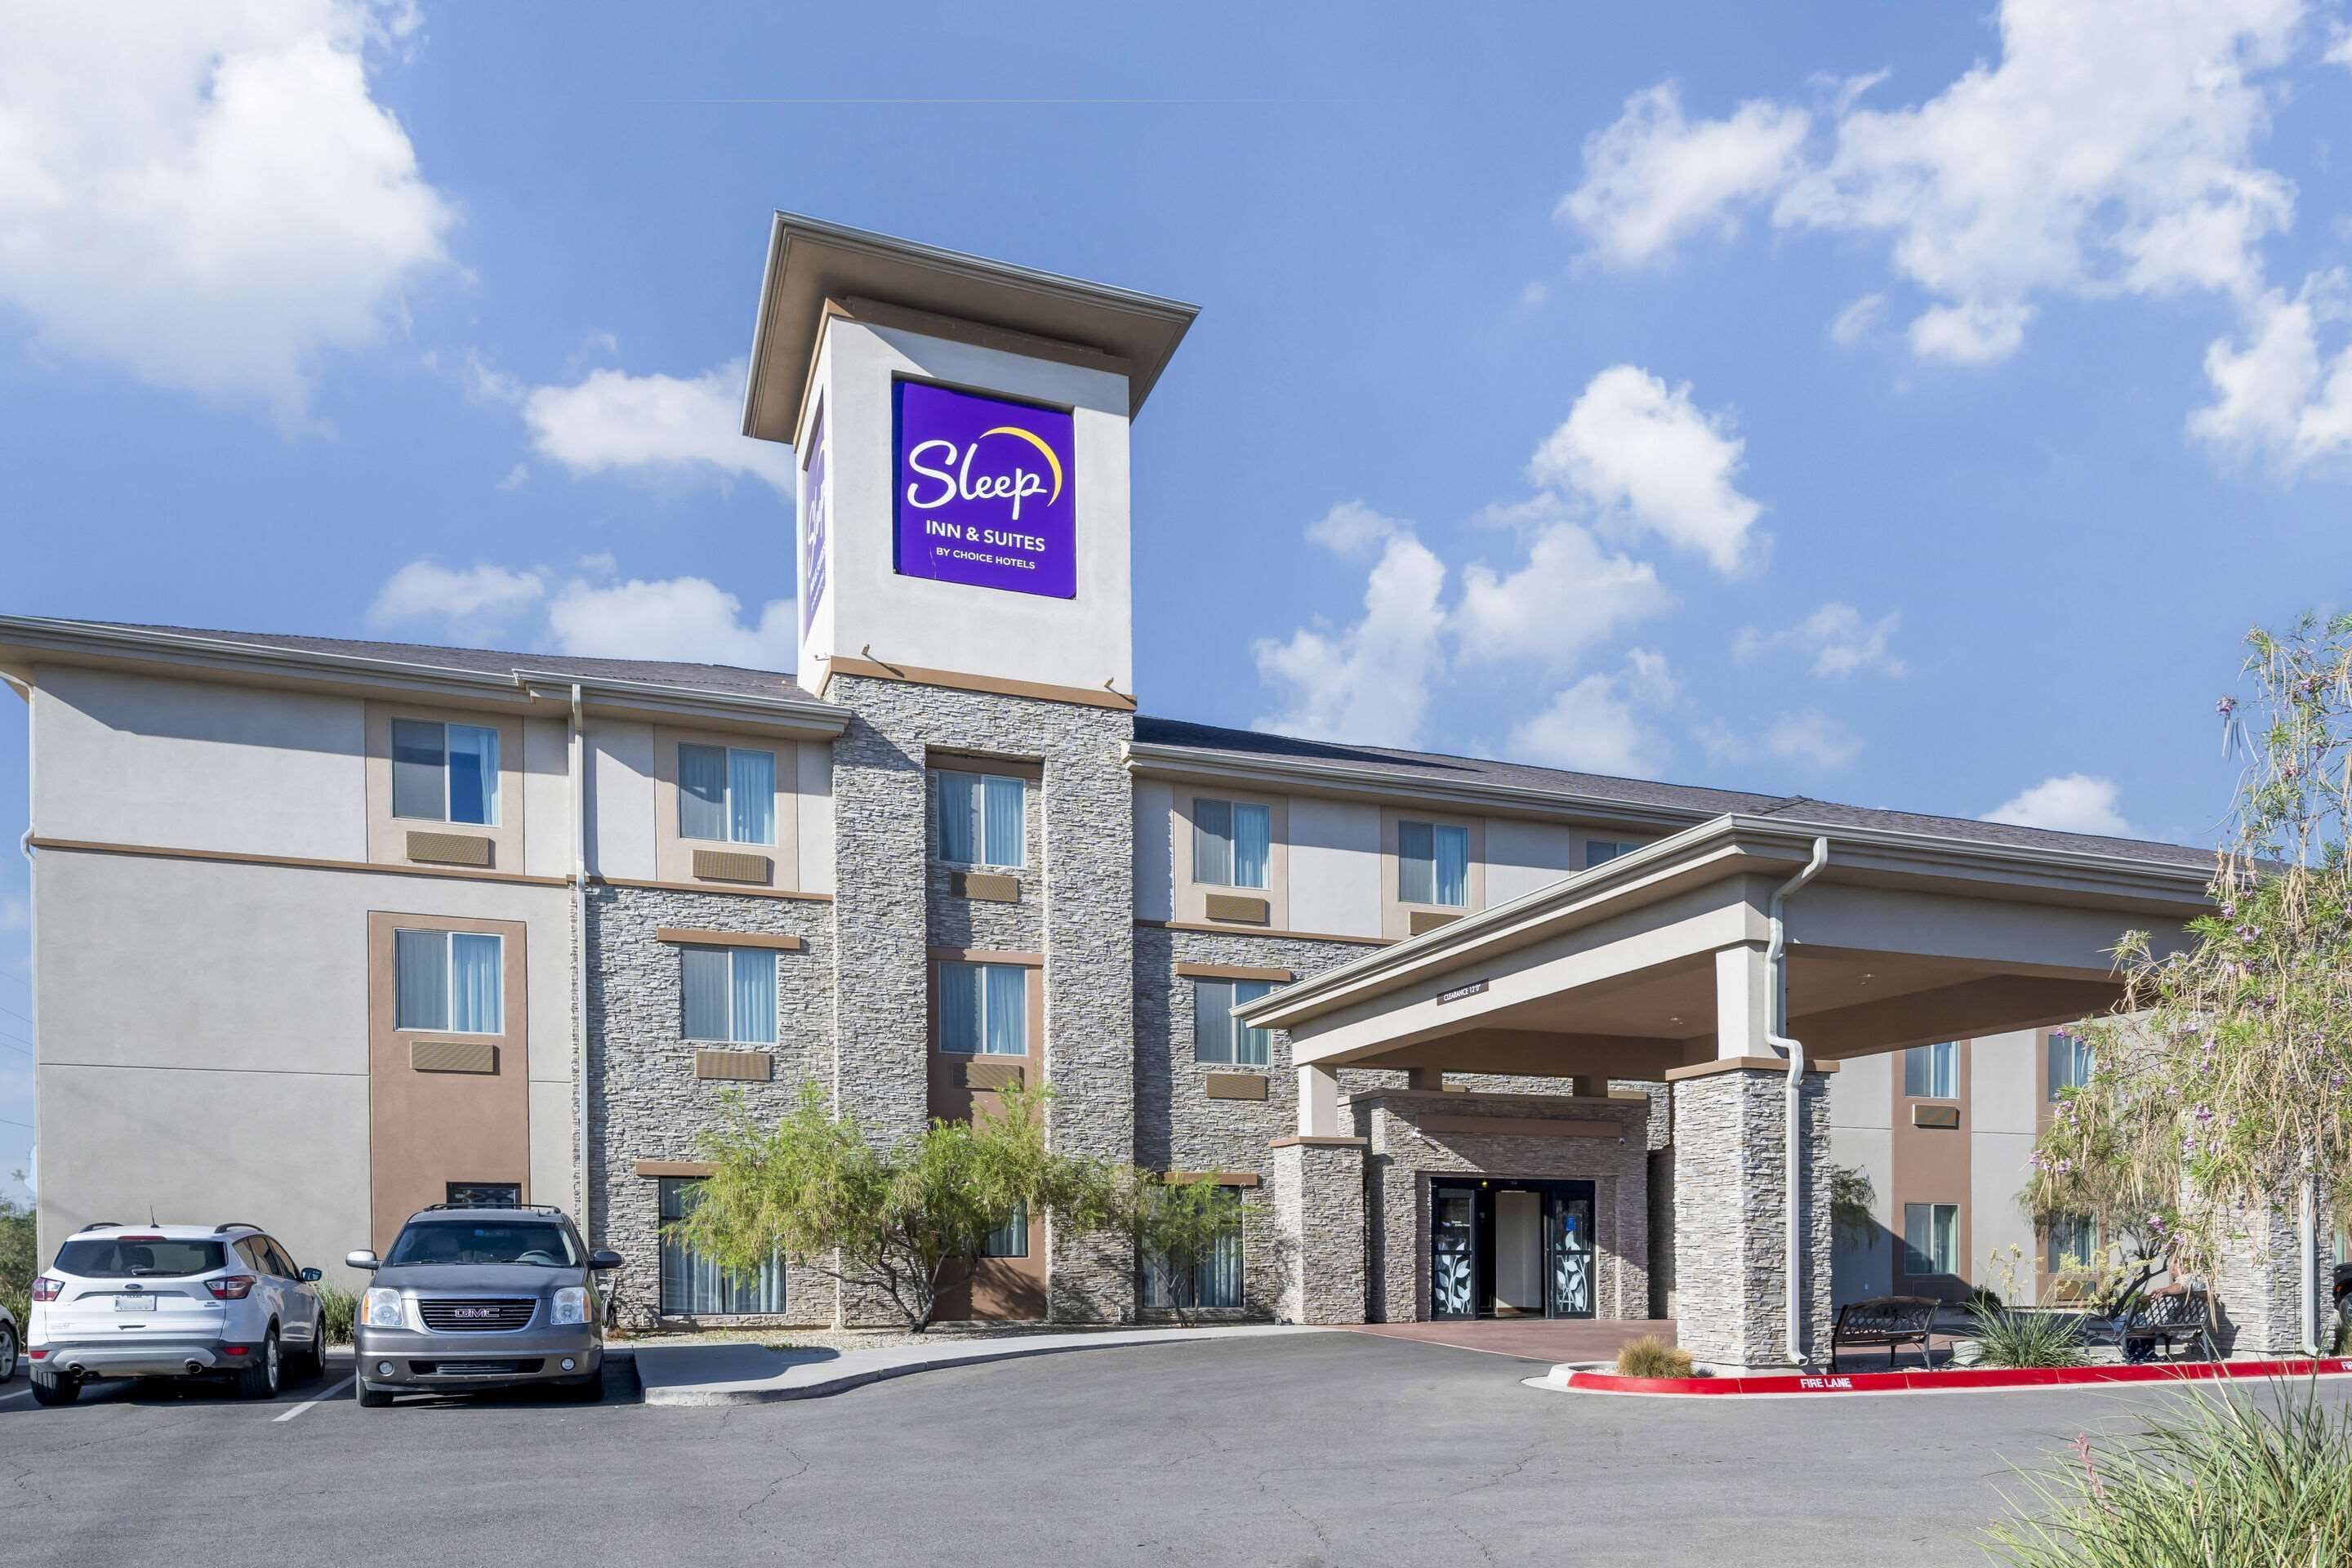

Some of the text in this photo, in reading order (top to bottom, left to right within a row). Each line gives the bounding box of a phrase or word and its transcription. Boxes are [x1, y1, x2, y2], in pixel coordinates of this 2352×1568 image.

[907, 439, 1047, 520] Sleep
[926, 519, 1045, 552] INN & SUITES
[936, 547, 1036, 569] BY CHOICE HOTELS
[1443, 988, 1469, 1001] CLEARANCE
[455, 1308, 500, 1317] GMC
[1800, 1378, 1852, 1389] FIRE LANE
